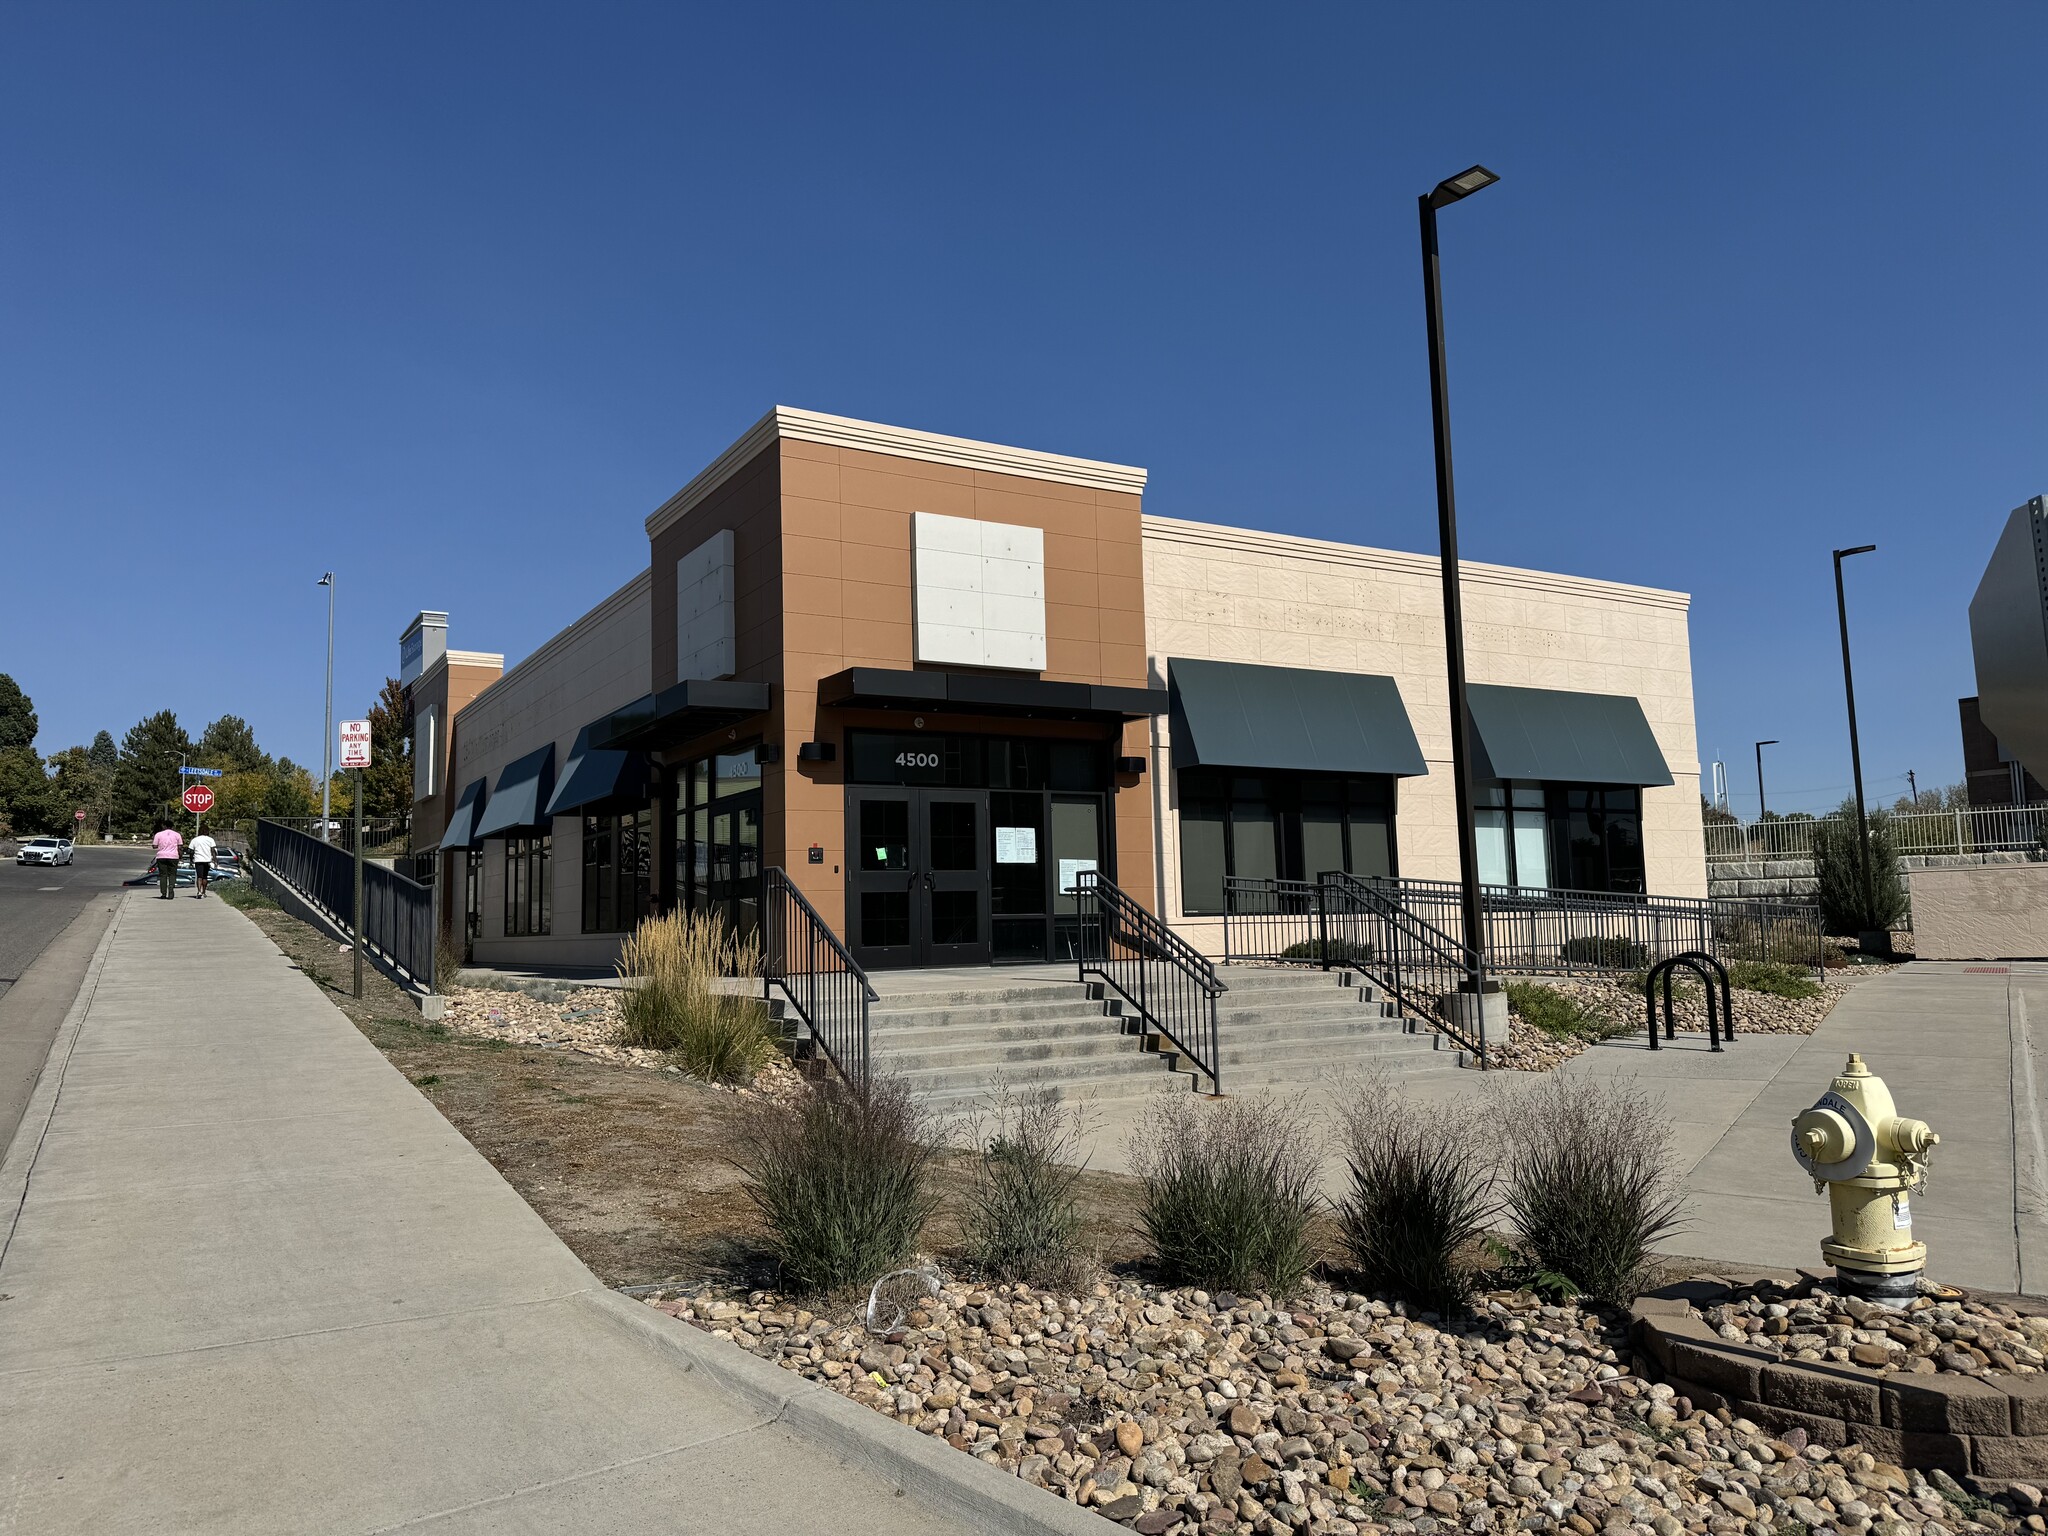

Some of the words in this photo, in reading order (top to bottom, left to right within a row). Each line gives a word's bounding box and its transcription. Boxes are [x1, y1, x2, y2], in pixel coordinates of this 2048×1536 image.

[350, 723, 361, 732] NO
[341, 733, 369, 742] PARKING
[895, 752, 939, 767] 4500
[185, 793, 212, 804] STOP
[1835, 1079, 1859, 1090] OPEN
